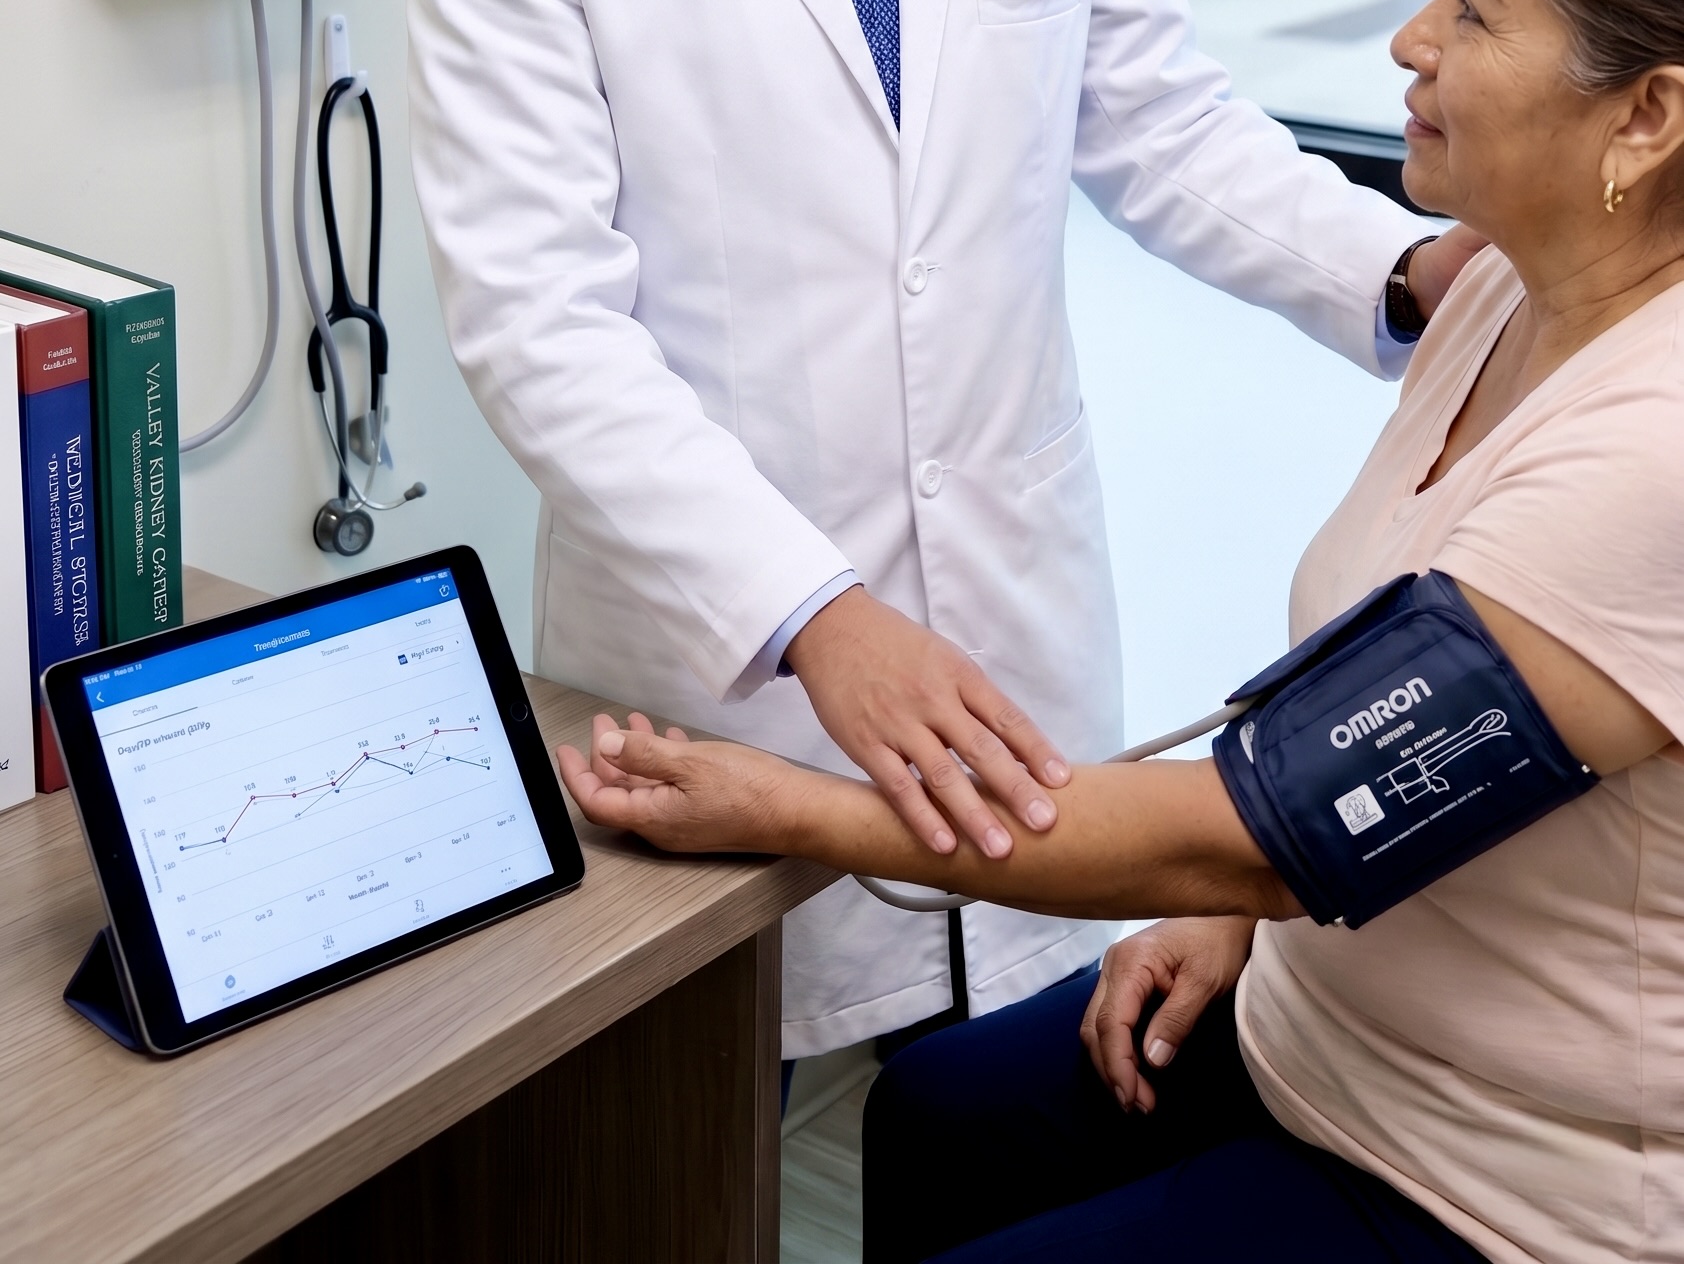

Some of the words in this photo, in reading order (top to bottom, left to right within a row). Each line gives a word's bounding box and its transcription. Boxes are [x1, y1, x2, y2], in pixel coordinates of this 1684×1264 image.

[146, 362, 163, 447] VALLEY
[150, 457, 166, 539] KIDNEY
[1329, 676, 1433, 750] OMRON
